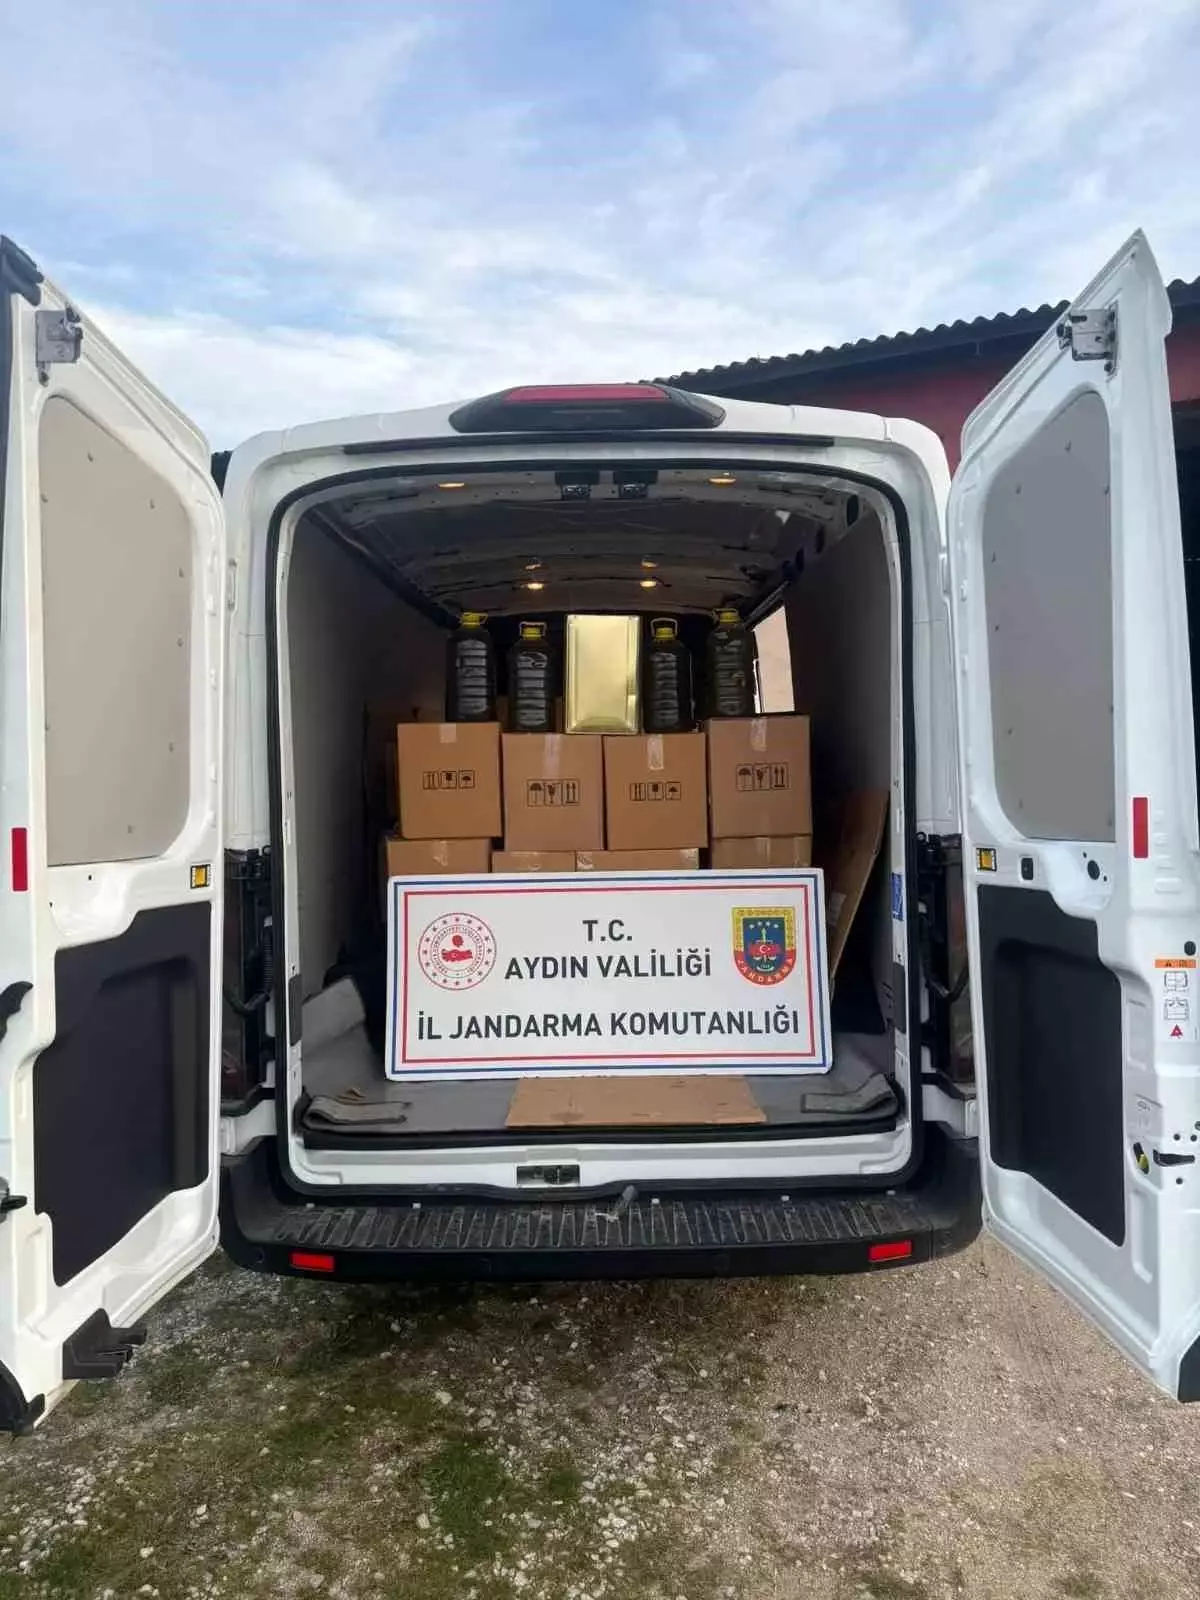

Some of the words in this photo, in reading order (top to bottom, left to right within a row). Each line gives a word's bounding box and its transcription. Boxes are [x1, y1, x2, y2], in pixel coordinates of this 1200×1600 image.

[582, 919, 633, 942] T.C.
[504, 955, 588, 980] AYDIN
[596, 948, 711, 978] VALİLİĞİ
[418, 1010, 442, 1041] İL
[449, 1013, 602, 1040] JANDARMA
[610, 1004, 799, 1036] KOMUTANLIĞI
